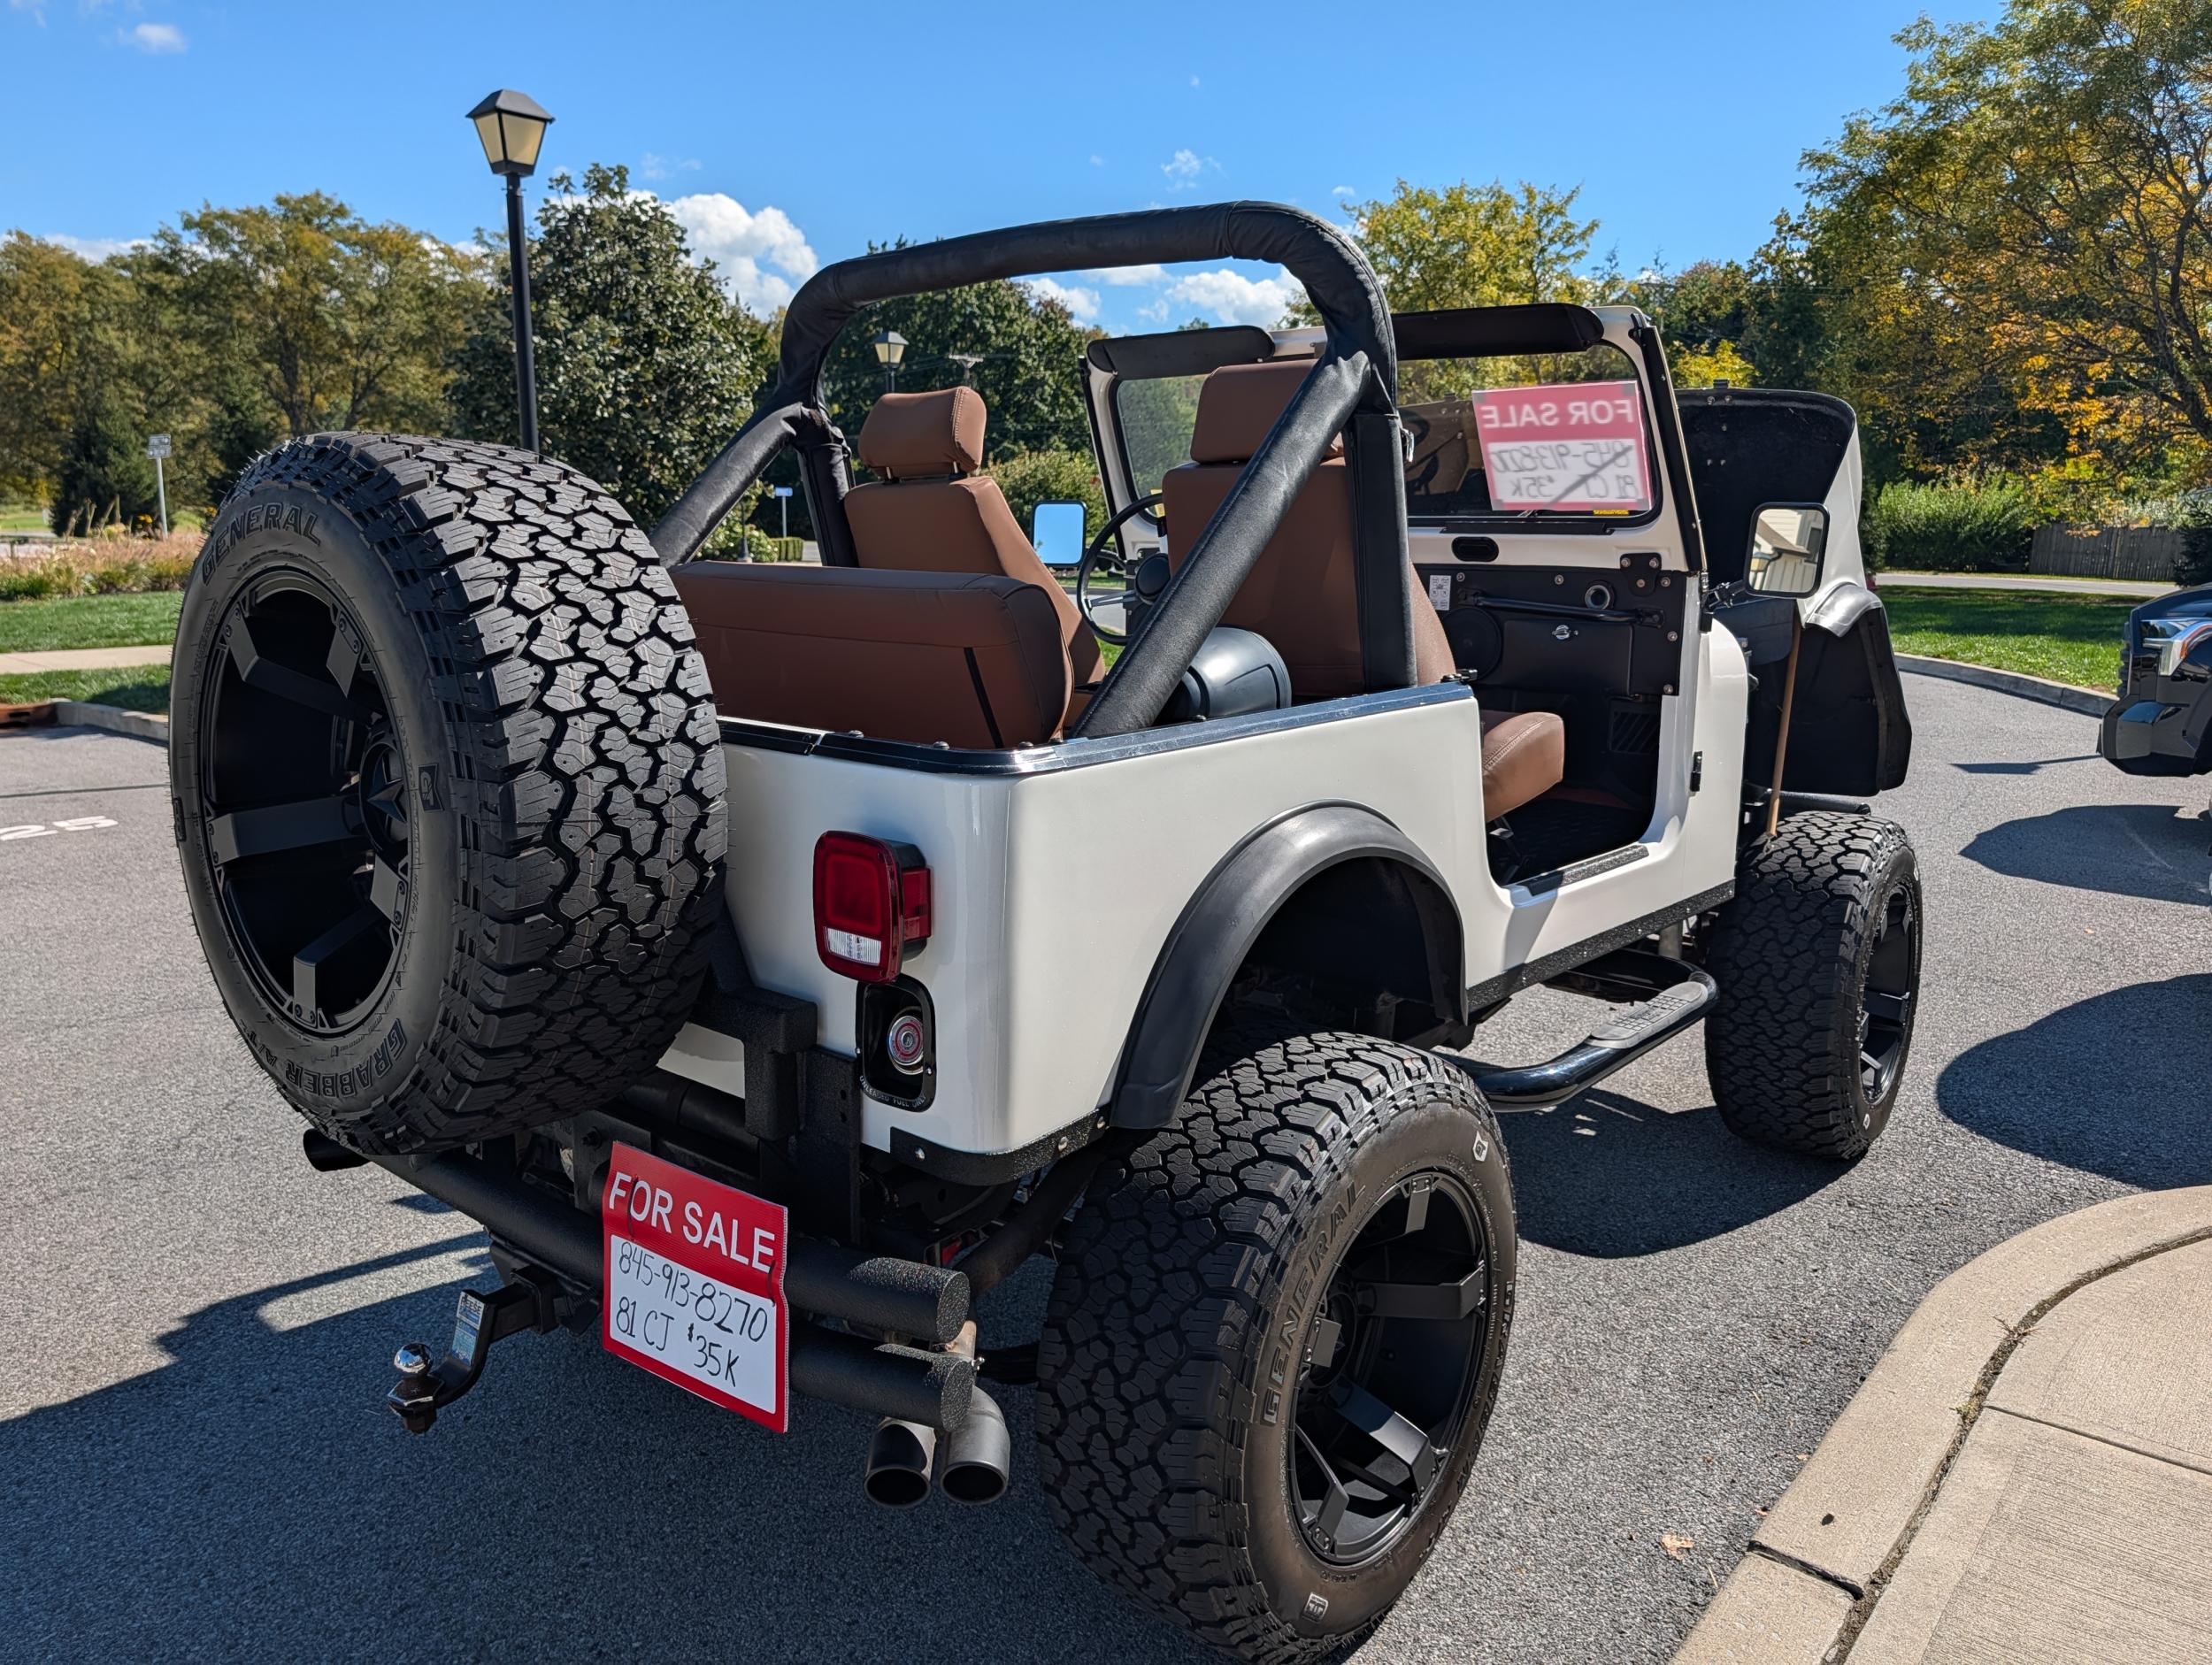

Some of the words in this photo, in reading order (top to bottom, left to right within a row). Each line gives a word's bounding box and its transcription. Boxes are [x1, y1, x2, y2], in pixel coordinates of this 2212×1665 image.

[202, 502, 321, 587] GENERAL
[284, 1018, 407, 1099] GRABBER
[608, 1171, 672, 1233] FOR
[682, 1201, 775, 1273] SALE
[616, 1296, 637, 1339] 81
[643, 1310, 675, 1352] CJ
[618, 1241, 768, 1342] 845-913-8270
[1260, 1181, 1367, 1427] GENERAL
